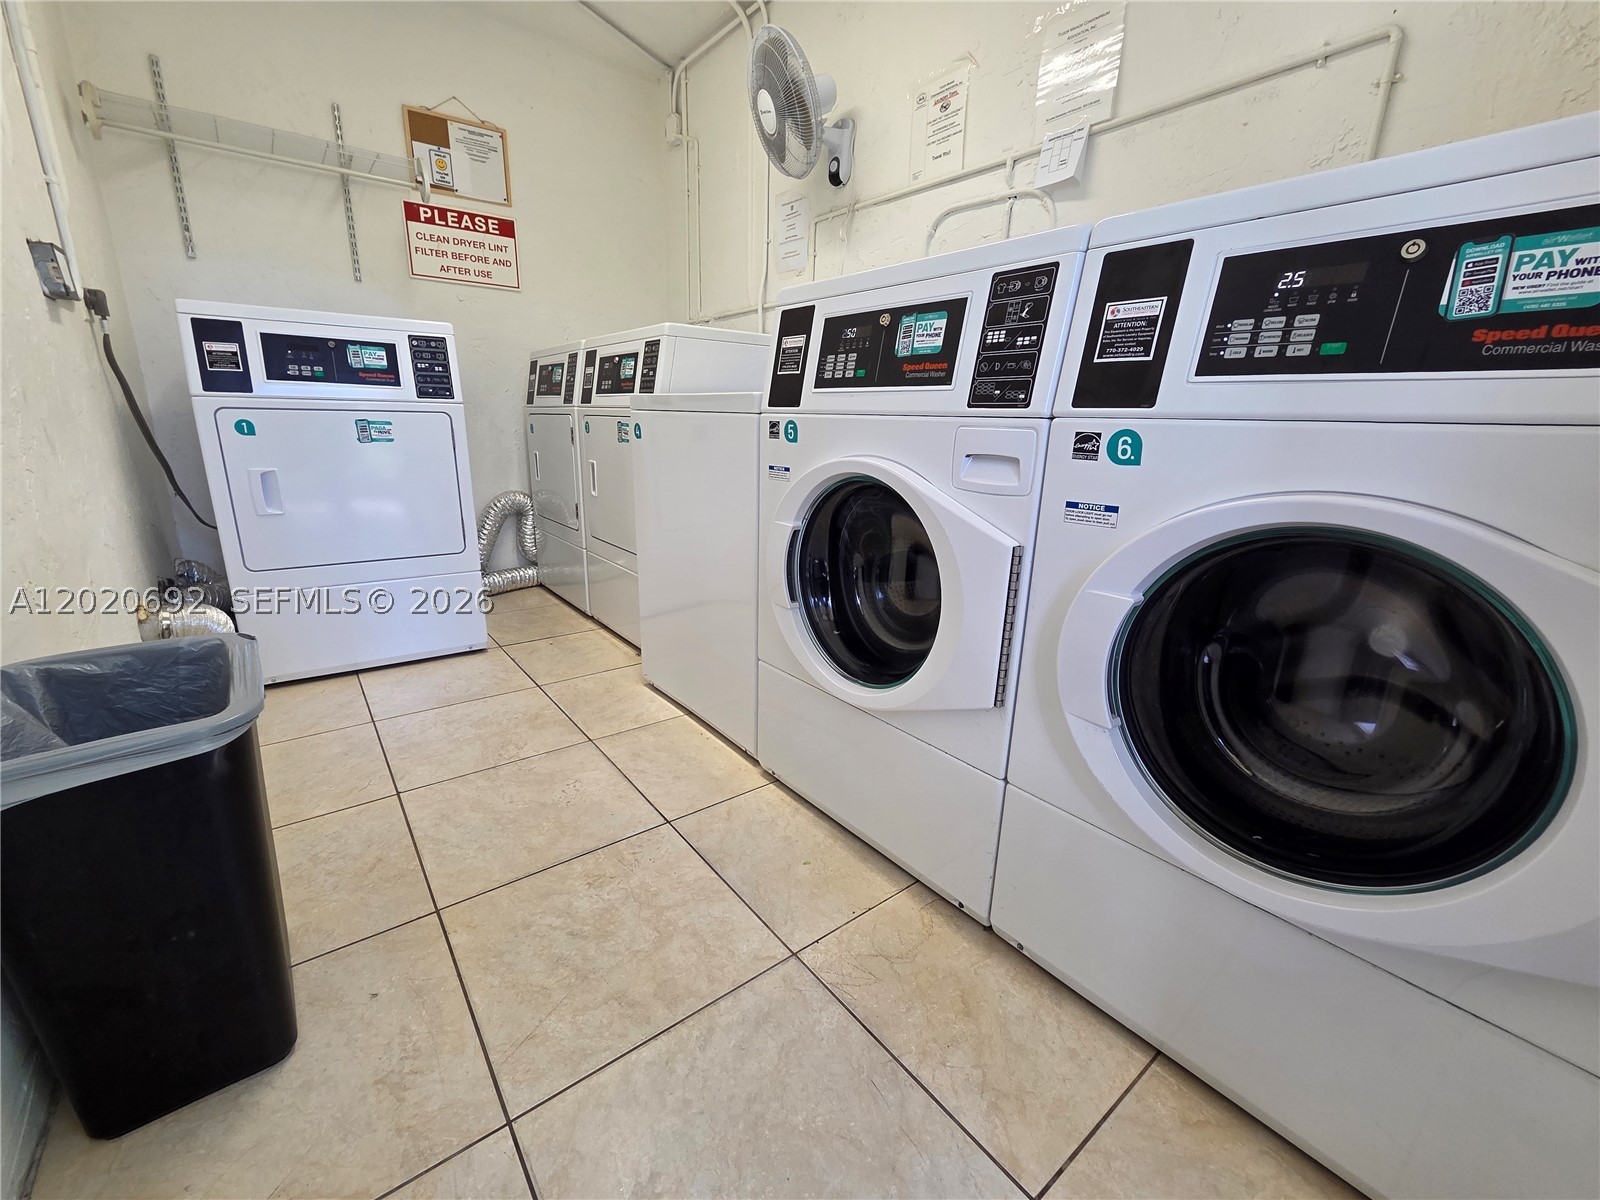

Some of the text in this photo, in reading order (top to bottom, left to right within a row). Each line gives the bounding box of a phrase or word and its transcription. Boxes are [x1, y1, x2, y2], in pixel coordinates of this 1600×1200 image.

[419, 206, 500, 234] PLEASE
[416, 232, 508, 253] CLEAN DRYER LINT
[1466, 242, 1505, 254] DOWNLOAD
[415, 246, 512, 268] FILTER BEFORE AND
[1513, 247, 1581, 272] PAY
[440, 265, 492, 279] AFTER USE
[1512, 266, 1600, 281] YOUR PHONE
[917, 322, 935, 333] PAY
[1471, 325, 1549, 344] Speed
[1482, 341, 1567, 356] Commercial
[902, 362, 924, 371] Speed
[241, 422, 248, 433] 1
[788, 424, 794, 439] 5
